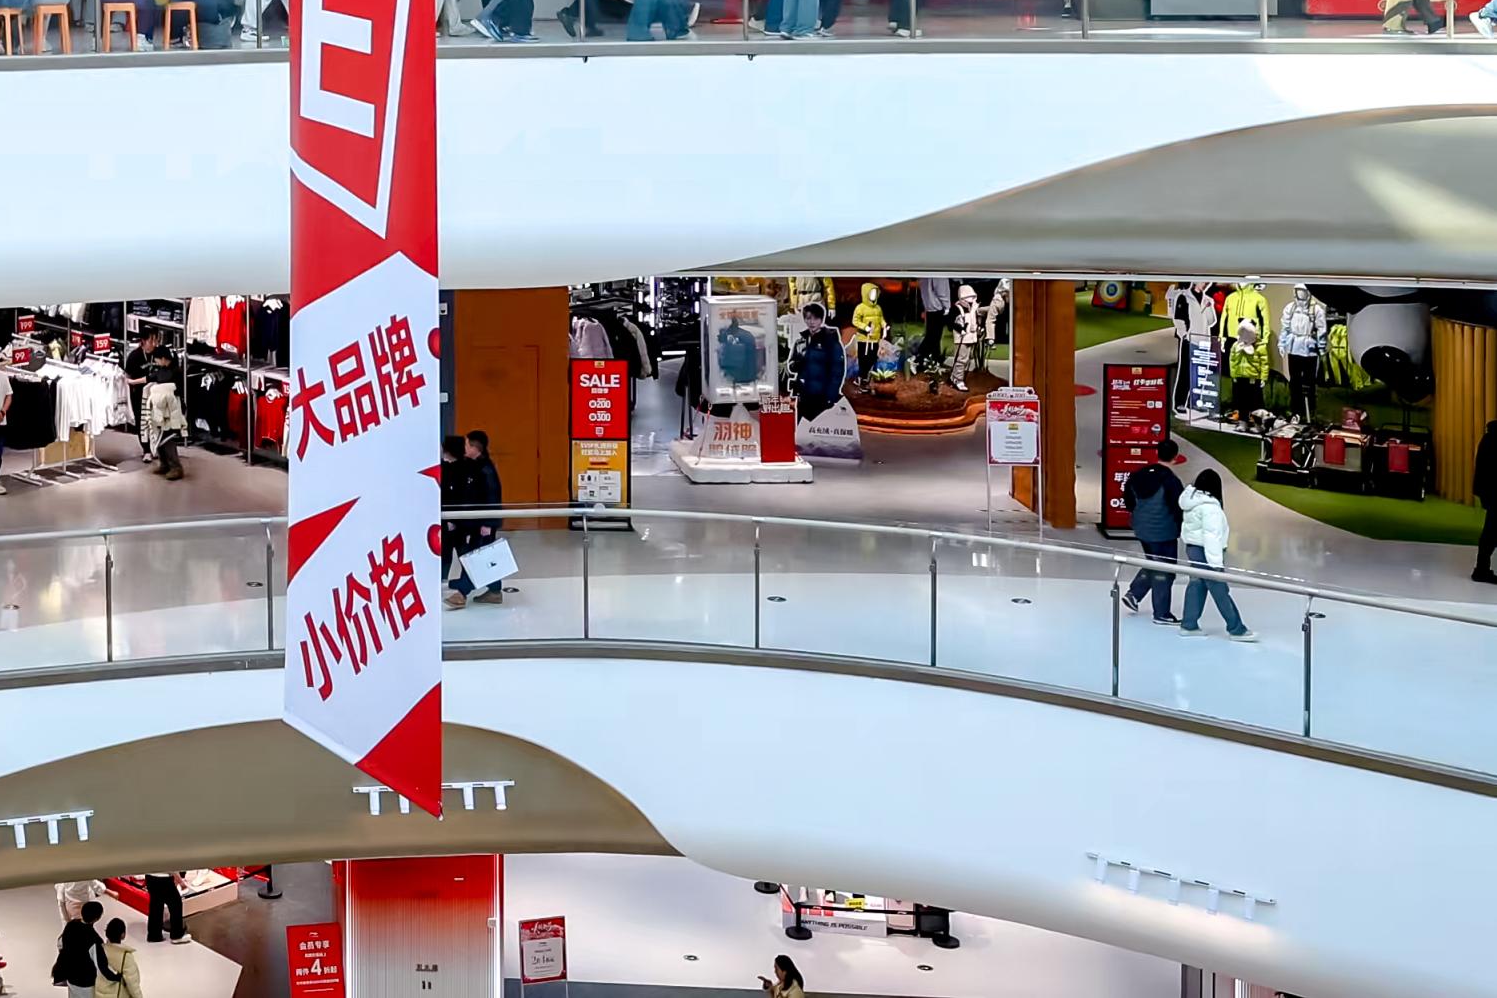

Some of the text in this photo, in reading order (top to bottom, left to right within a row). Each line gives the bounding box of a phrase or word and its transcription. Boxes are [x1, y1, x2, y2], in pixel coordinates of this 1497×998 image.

[96, 339, 108, 349] 159
[291, 314, 427, 462] 大品牌
[580, 374, 620, 388] SALE
[714, 422, 752, 440] 羽神
[300, 533, 428, 701] 小价格
